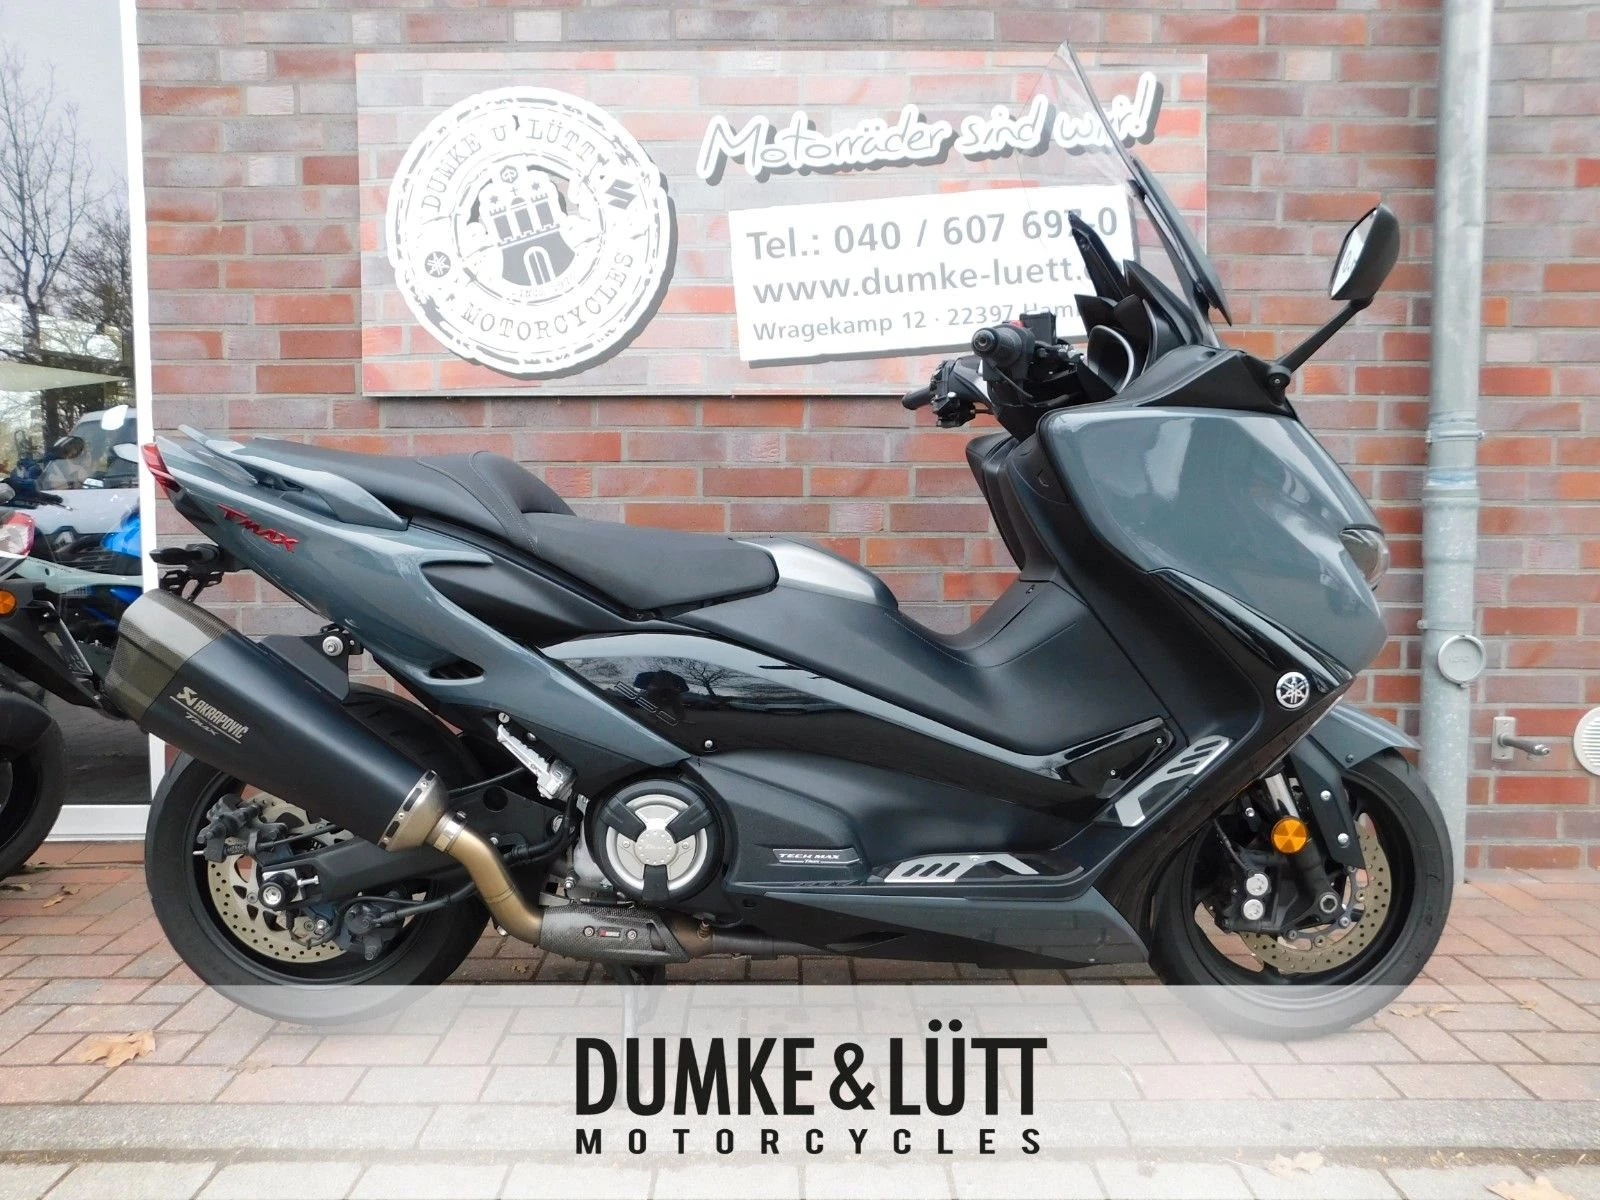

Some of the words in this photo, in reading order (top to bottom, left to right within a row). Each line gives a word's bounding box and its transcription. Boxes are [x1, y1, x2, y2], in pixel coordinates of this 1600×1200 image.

[421, 133, 482, 213] DUMKE
[526, 118, 597, 163] LÜTT
[699, 107, 949, 176] Motorräder
[958, 97, 1046, 151] sind
[746, 227, 820, 260] Tel.:
[834, 221, 901, 254] 040
[943, 213, 1005, 245] 607
[460, 252, 634, 341] MOTORCYCLES
[753, 257, 1122, 303] www.dumke-luett.
[753, 316, 893, 342] Wragekamp
[902, 311, 927, 329] 12
[948, 304, 1014, 326] 22397
